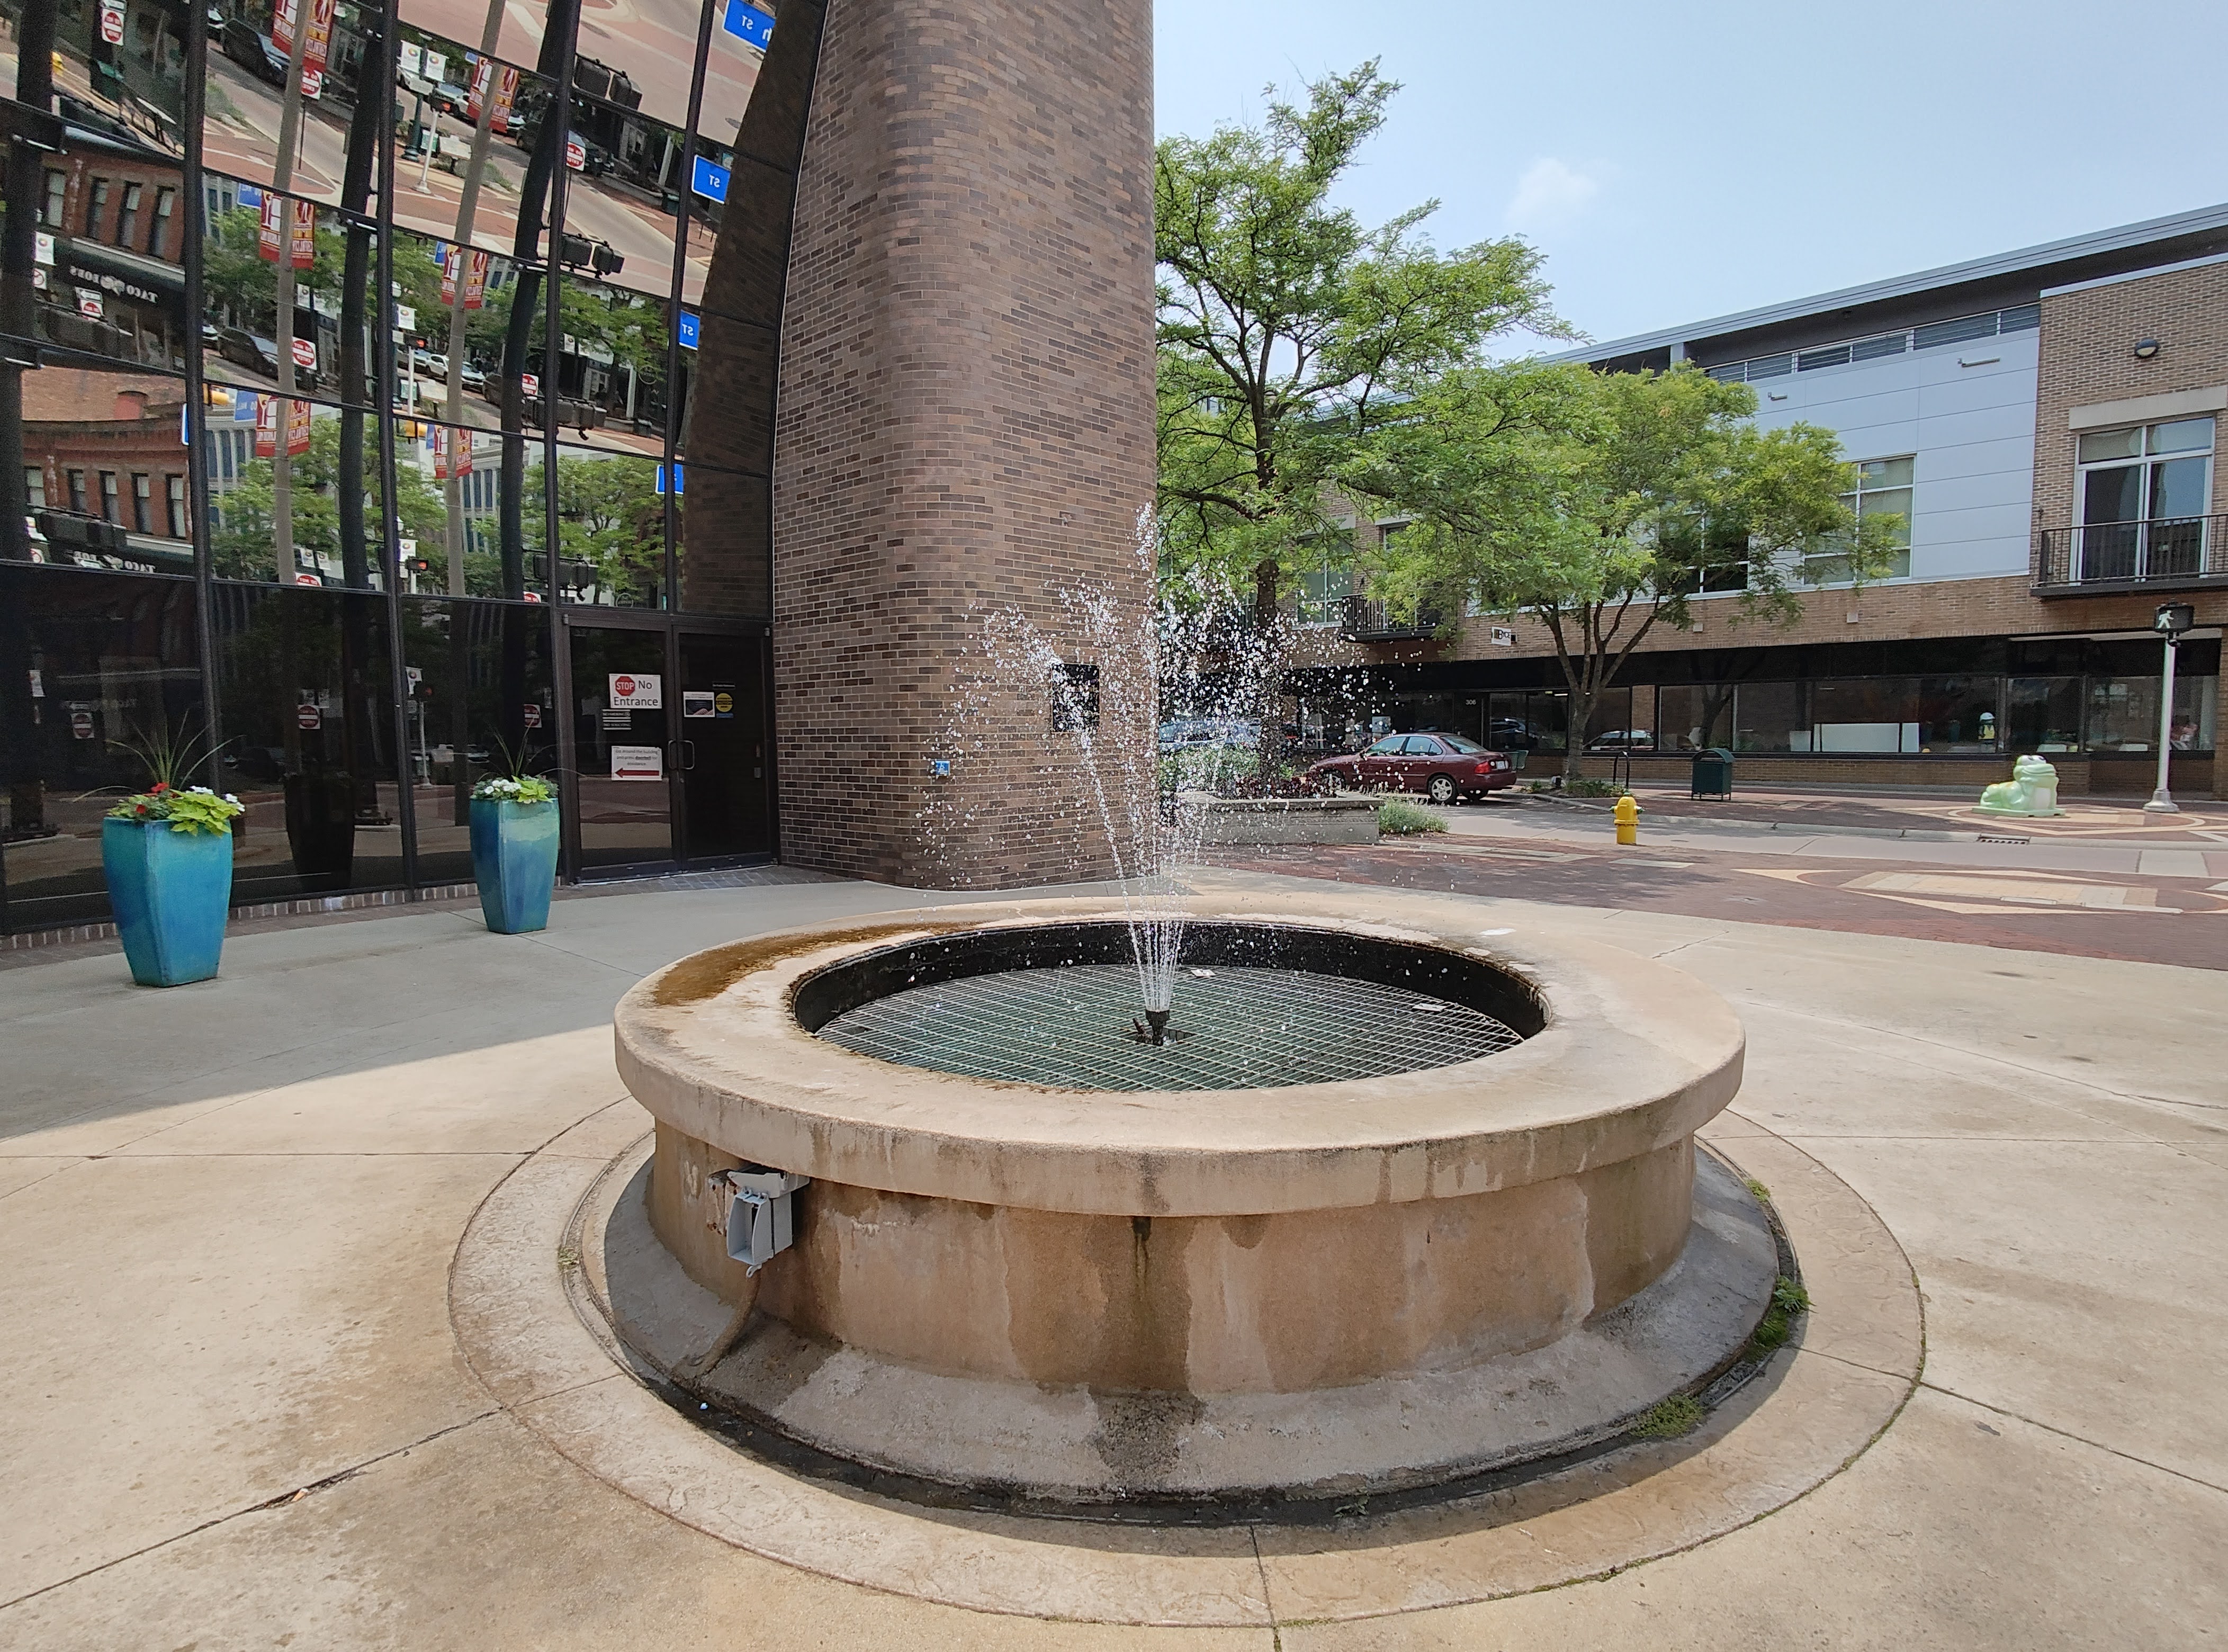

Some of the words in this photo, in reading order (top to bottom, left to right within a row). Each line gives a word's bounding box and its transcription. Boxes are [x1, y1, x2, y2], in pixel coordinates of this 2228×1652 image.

[616, 681, 634, 691] STOP
[638, 680, 652, 690] No
[614, 696, 659, 706] Entrance
